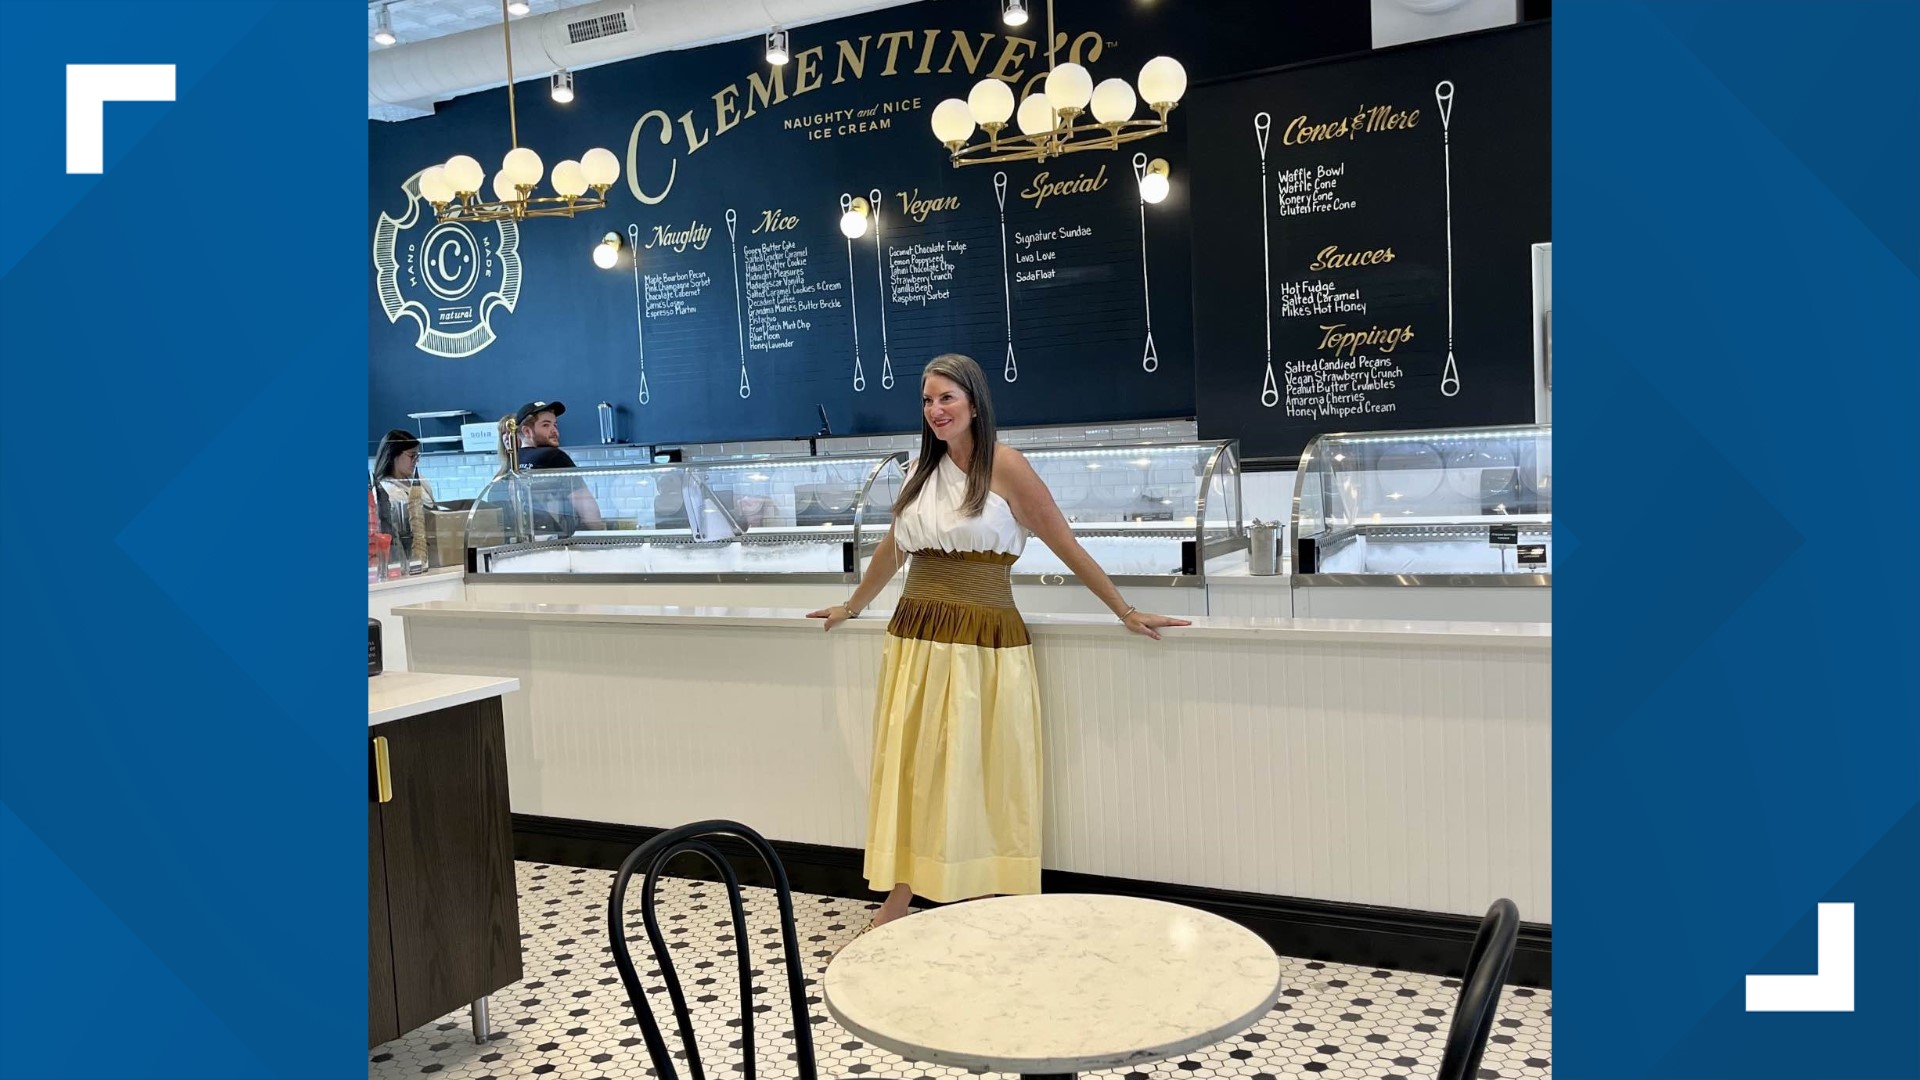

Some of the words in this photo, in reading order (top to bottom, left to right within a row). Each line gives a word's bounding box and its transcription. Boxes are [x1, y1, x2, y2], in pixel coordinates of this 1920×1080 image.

[784, 108, 854, 130] NAUGHTY
[856, 103, 879, 118] and
[883, 97, 922, 114] NICE
[808, 128, 832, 140] ICE
[838, 118, 891, 136] CREAM
[1283, 115, 1349, 146] Cones
[1366, 104, 1420, 132] More
[1278, 167, 1312, 183] Waffle
[1317, 162, 1344, 178] Bowl
[1021, 164, 1108, 209] Special
[1278, 180, 1312, 194] Waffle
[1314, 178, 1337, 190] Cone
[896, 188, 960, 223] Vegan
[1278, 193, 1312, 206] Konery
[1312, 190, 1333, 201] Cone
[1280, 204, 1311, 216] Gluten
[1312, 201, 1332, 212] Free
[1333, 198, 1356, 210] Cone
[752, 208, 800, 234] Nice
[645, 220, 712, 253] Naughty
[1015, 229, 1057, 249] Signature
[1059, 225, 1092, 239] Sundae
[744, 246, 761, 257] Gooey
[762, 243, 781, 253] Butter
[782, 240, 795, 250] Cake
[763, 251, 784, 261] Cracker
[785, 247, 808, 259] Caramel
[889, 246, 913, 257] Coconut
[914, 242, 945, 254] Chocolate
[947, 240, 967, 255] Fudge
[1016, 252, 1034, 263] Lava
[1036, 250, 1056, 261] Love
[407, 244, 418, 287] HAND
[482, 236, 493, 278] MADE
[438, 239, 462, 282] C
[745, 262, 765, 273] Italian
[766, 260, 785, 271] Butter
[787, 258, 807, 268] Cookie
[890, 256, 910, 266] Lemon
[911, 254, 944, 266] Poppyseed
[1309, 245, 1396, 272] Sauces
[745, 271, 772, 282] Midnight
[773, 268, 804, 279] Pleasures
[889, 265, 908, 276] Tahini
[909, 263, 940, 273] Chocolate
[940, 260, 955, 272] Chip
[1016, 271, 1035, 283] Soda
[1035, 268, 1056, 279] Float
[645, 274, 662, 285] Maple
[663, 272, 688, 283] Bourbon
[689, 270, 706, 279] Pecan
[645, 281, 658, 293] Pink
[658, 280, 690, 292] Champagne
[690, 277, 711, 288] Sorbet
[746, 279, 782, 290] Madagascar
[783, 276, 805, 286] Vanilla
[890, 274, 930, 285] Strawberry
[930, 270, 953, 281] Crunch
[645, 290, 673, 301] Chocolate
[674, 287, 700, 298] Cabernet
[746, 289, 765, 298] Salted
[765, 286, 791, 297] Caramel
[792, 285, 815, 294] Cookies
[821, 280, 842, 291] Cream
[891, 284, 914, 294] Vanilla
[914, 283, 933, 293] Bean
[1281, 282, 1300, 295] Hot
[1302, 280, 1336, 296] Fudge
[747, 297, 775, 307] Decadent
[776, 295, 796, 305] Coffee
[892, 293, 925, 307] Raspberry
[926, 289, 950, 300] Sorbet
[1281, 293, 1314, 306] Salted
[1317, 289, 1360, 303] Caramel
[439, 308, 473, 321] natural
[646, 308, 674, 320] Espresso
[675, 305, 697, 315] Martini
[748, 306, 774, 316] Grandma
[798, 300, 819, 311] Butter
[820, 298, 842, 309] Brickle
[1313, 303, 1332, 315] Hot
[1335, 300, 1367, 316] Honey
[749, 315, 776, 324] Pistachio
[750, 323, 765, 333] Front
[765, 321, 781, 332] Porch
[782, 320, 796, 330] Mint
[796, 319, 811, 331] Chip
[750, 332, 763, 342] Blue
[763, 331, 780, 341] Moon
[1317, 323, 1415, 357] Toppings
[750, 341, 768, 352] Honey
[768, 338, 794, 349] Lavender
[1285, 359, 1318, 373] Salted
[1319, 356, 1356, 370] Candied
[1359, 355, 1392, 368] Pecans
[1285, 372, 1314, 386] Vegan
[1315, 370, 1370, 384] Strawberry
[1370, 366, 1403, 379] Crunch
[1286, 383, 1315, 395] Peanut
[1316, 381, 1350, 393] Butter
[1352, 379, 1396, 391] Crumbles
[1286, 395, 1324, 406] Amarena
[1326, 392, 1365, 404] Cherries
[1286, 405, 1317, 421] Honey
[1318, 401, 1363, 418] Whipped
[1365, 400, 1396, 413] Cream
